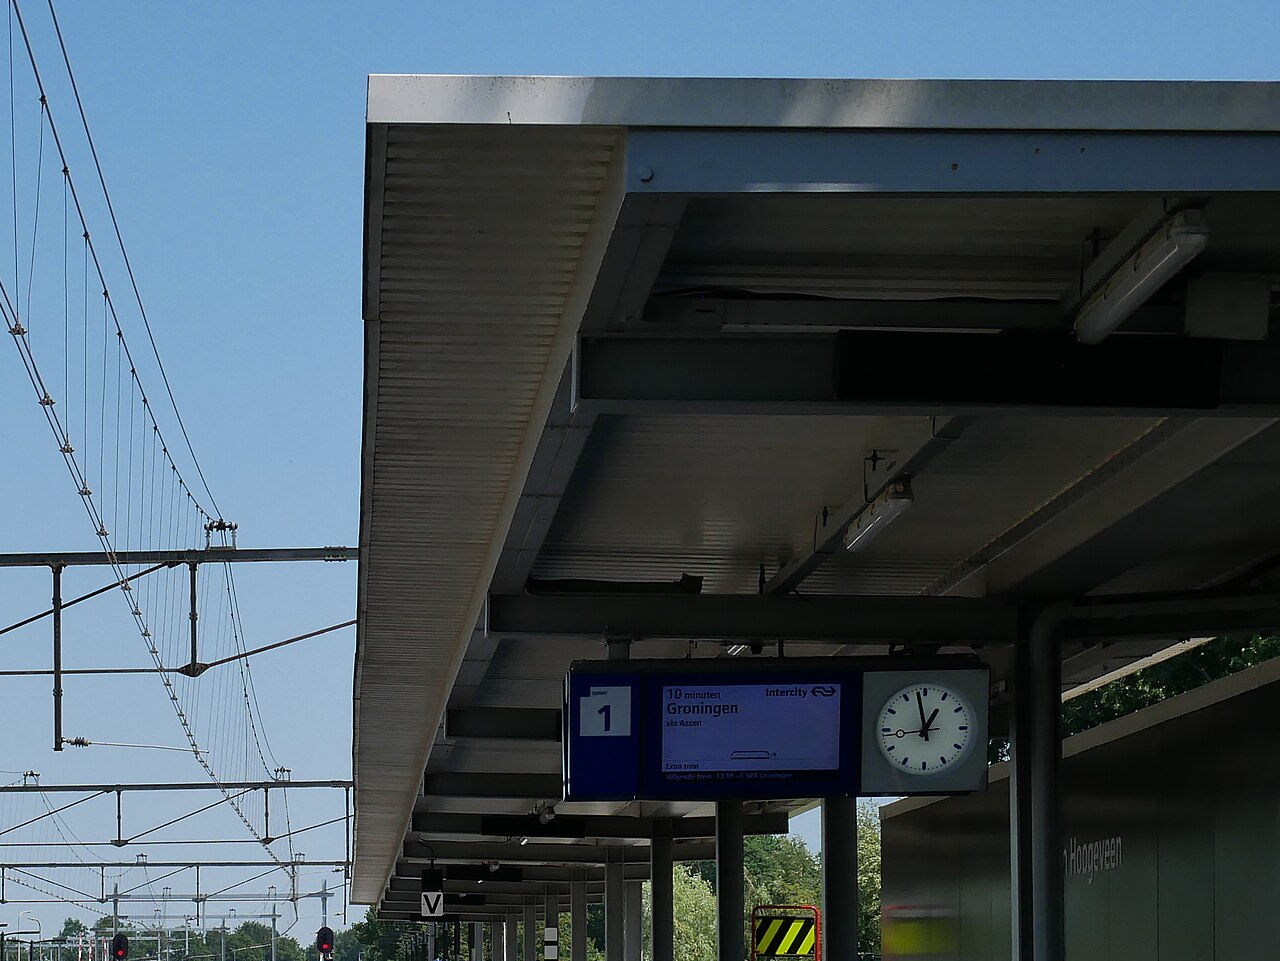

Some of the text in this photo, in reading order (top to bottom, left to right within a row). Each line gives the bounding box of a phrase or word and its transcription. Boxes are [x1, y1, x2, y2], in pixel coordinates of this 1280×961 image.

[666, 688, 721, 699] 10 minuten
[765, 687, 808, 698] Intercity
[667, 702, 739, 717] Groningen
[597, 704, 611, 731] 1
[423, 894, 441, 914] V
